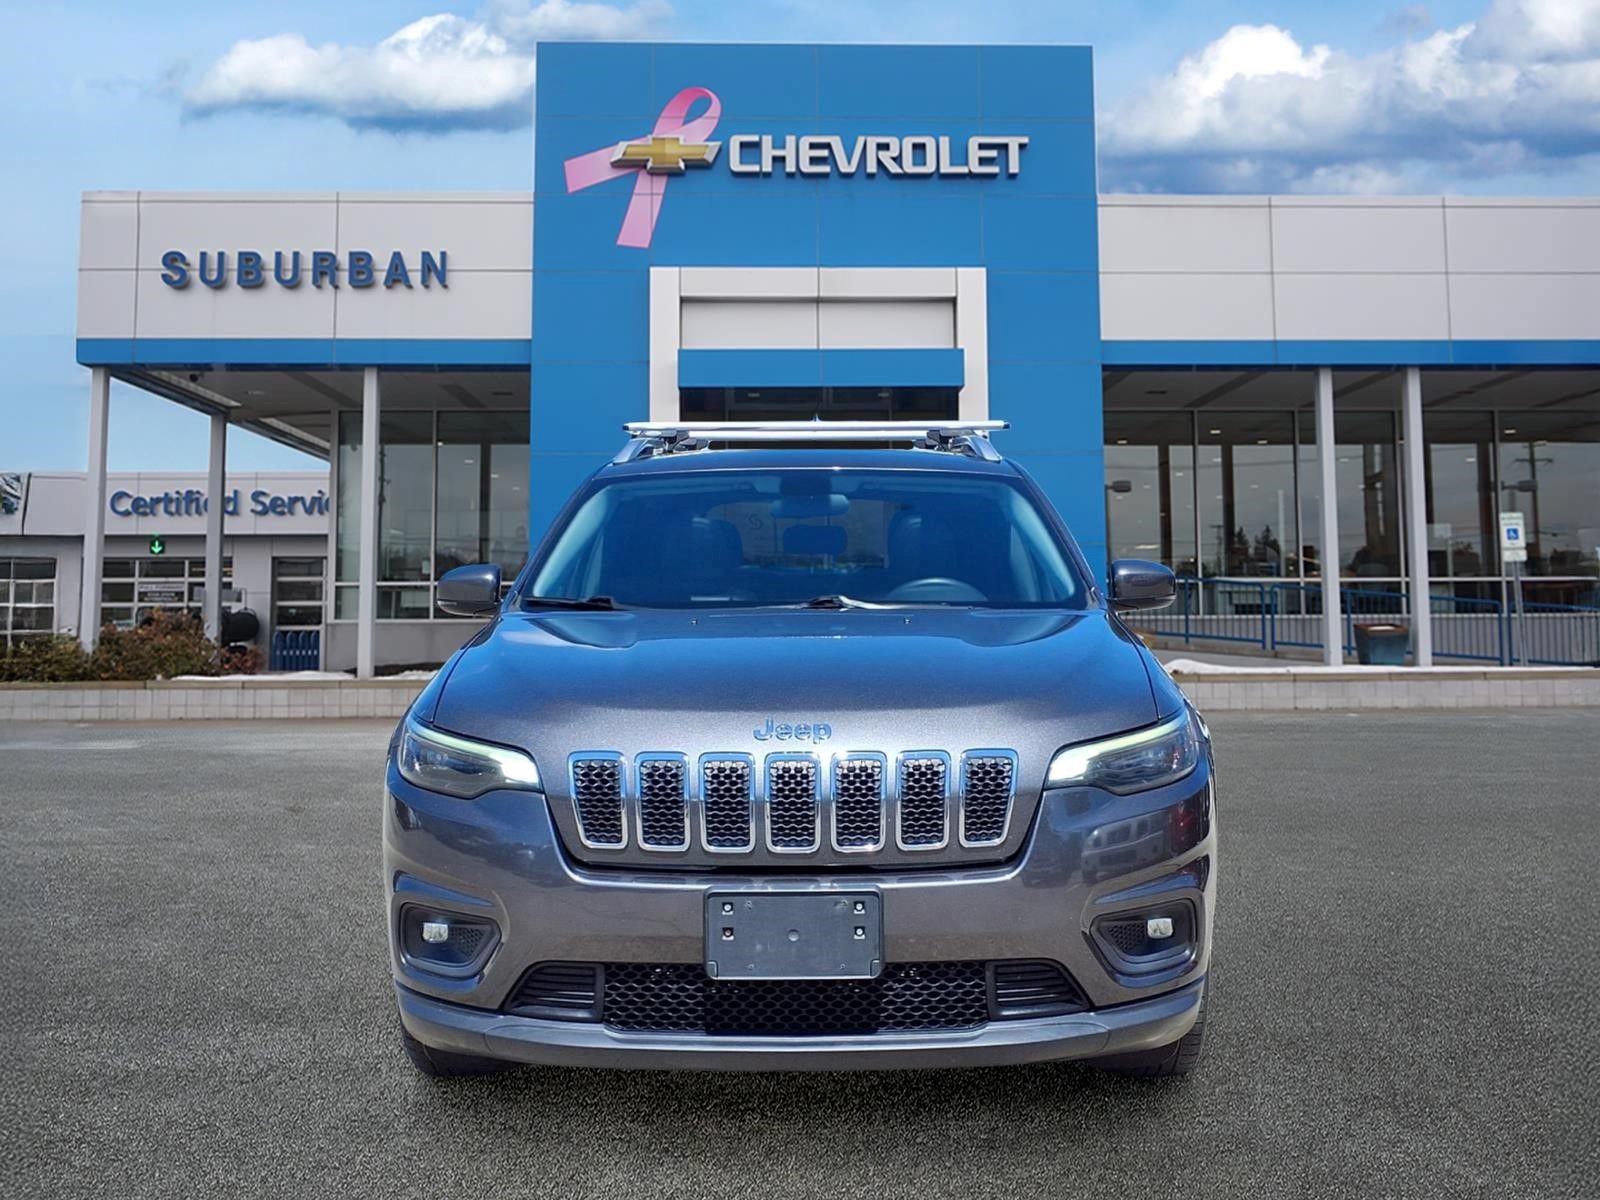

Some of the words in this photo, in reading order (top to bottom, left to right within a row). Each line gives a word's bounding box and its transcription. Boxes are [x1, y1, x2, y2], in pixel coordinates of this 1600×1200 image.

[729, 134, 1029, 177] CHEVROLET
[161, 250, 448, 290] SUBURBAN
[110, 489, 239, 516] Certifid
[250, 489, 330, 516] Servi
[753, 717, 832, 744] Jeep
